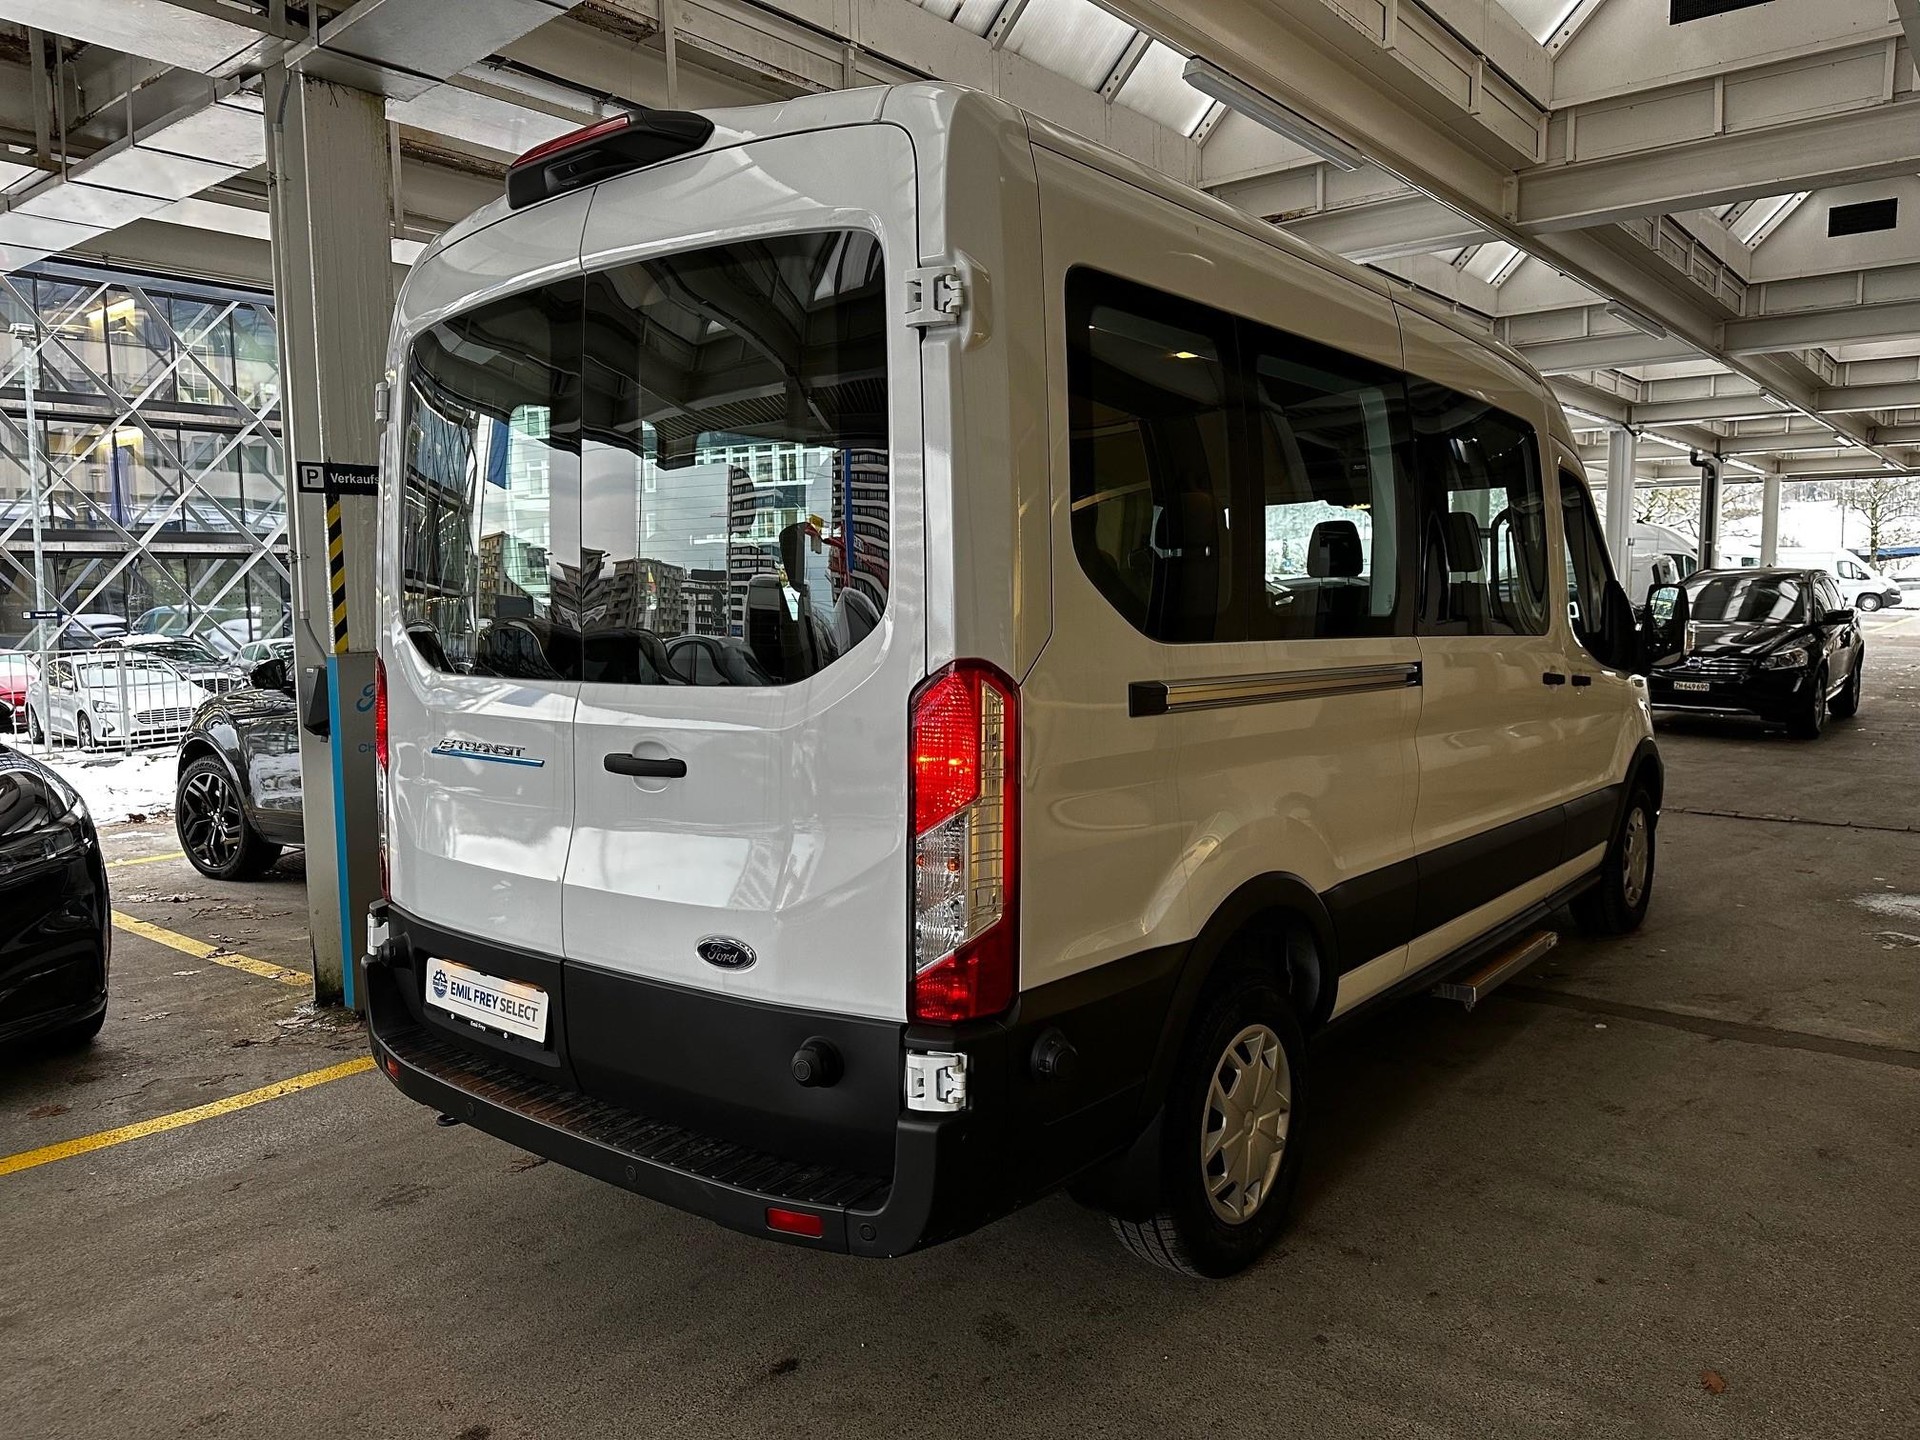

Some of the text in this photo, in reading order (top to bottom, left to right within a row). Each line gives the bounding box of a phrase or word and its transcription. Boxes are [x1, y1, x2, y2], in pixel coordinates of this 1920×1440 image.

[306, 469, 319, 485] P
[707, 943, 739, 964] Ford
[450, 981, 472, 1002] EMIL
[473, 989, 499, 1010] FREY
[499, 997, 539, 1022] SELECT
